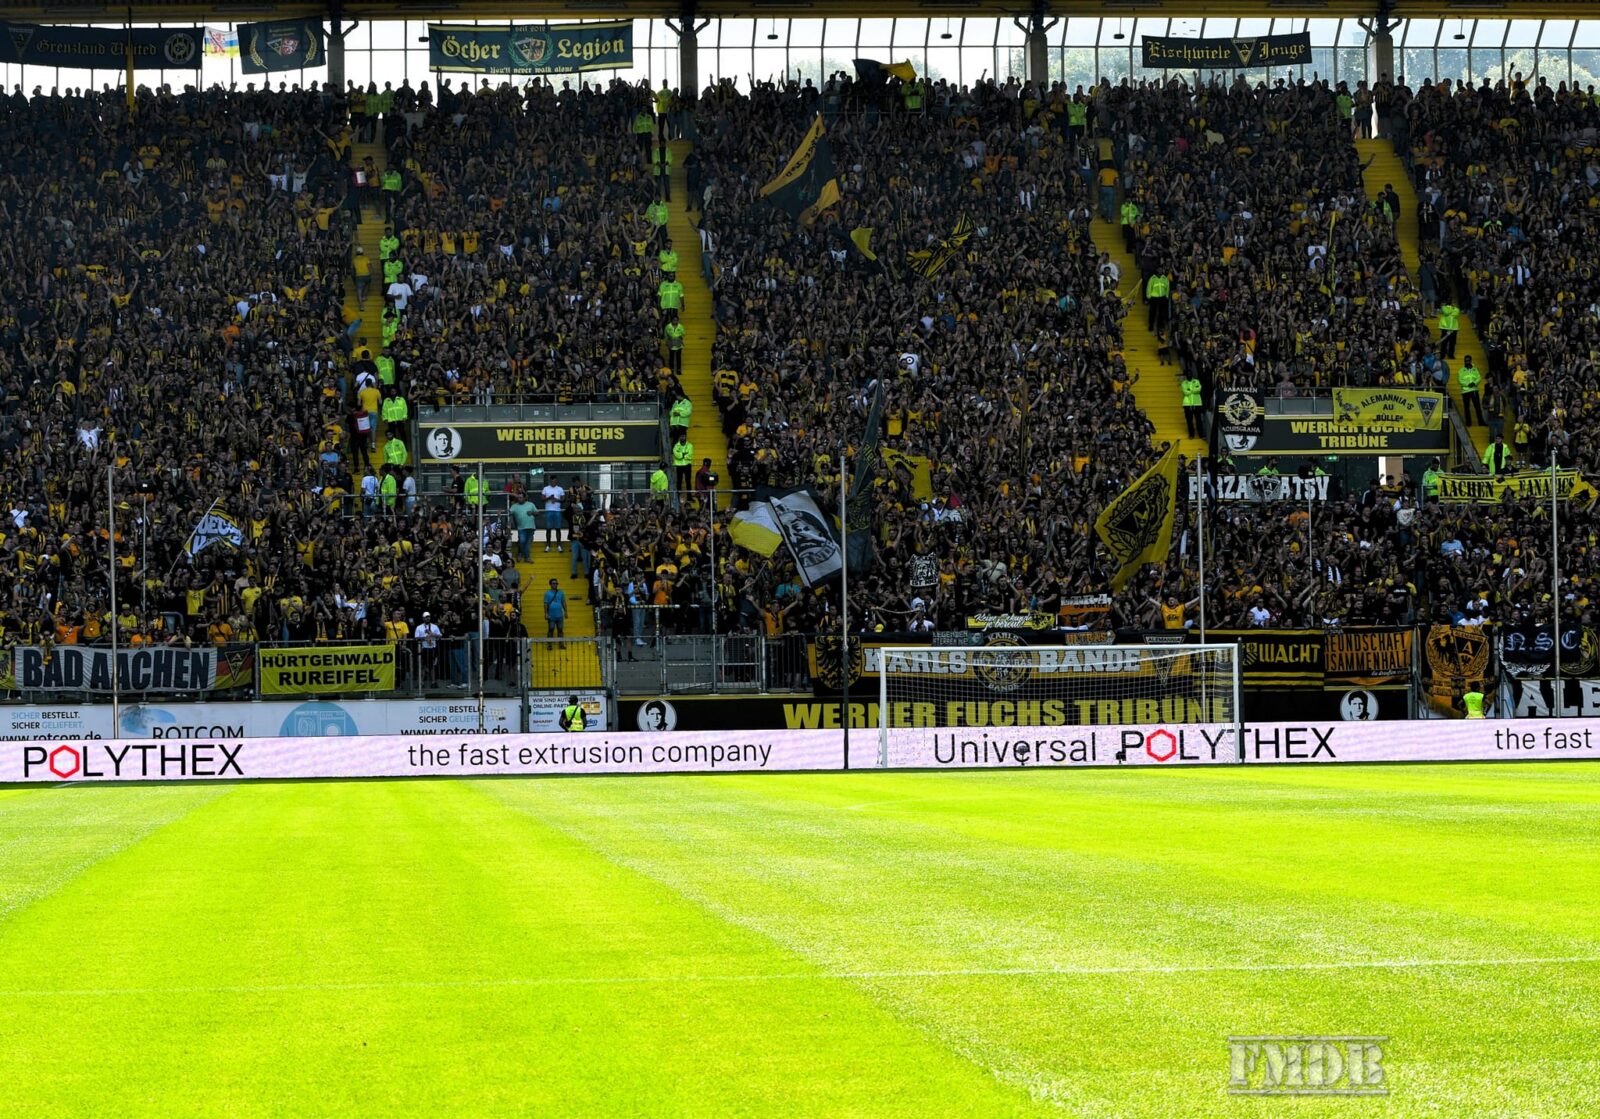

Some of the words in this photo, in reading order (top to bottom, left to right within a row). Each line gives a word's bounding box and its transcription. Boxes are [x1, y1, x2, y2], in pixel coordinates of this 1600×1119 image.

[441, 35, 501, 62] Öcher
[557, 38, 625, 60] Legion
[1146, 41, 1231, 63] Eischwiele
[497, 428, 566, 441] WERNER
[571, 427, 625, 440] FUCHS
[1319, 434, 1388, 448] TRIBÜNE
[525, 441, 597, 456] TRIBÜNE
[1440, 479, 1494, 498] AACHEN
[262, 651, 393, 668] HÜRTGENWALD
[864, 648, 967, 673] KARLS
[1038, 650, 1140, 672] BANDE
[1259, 643, 1321, 663] WACHT
[23, 649, 83, 688] BAD
[90, 649, 210, 690] AACHEN
[279, 669, 379, 687] RUREIFEL
[41, 711, 80, 719] BESTELLT.
[449, 705, 487, 713] BESTELT.
[783, 702, 936, 728] WERNER
[947, 700, 1066, 726] FUCHS
[1074, 695, 1231, 725] TRIBÜNE
[11, 721, 40, 729] SICHER
[153, 726, 243, 739] ROTCOM
[935, 732, 1096, 763] Universal
[1121, 727, 1336, 761] POLYTHEX
[1494, 728, 1535, 749] the
[1543, 727, 1592, 749] fast
[24, 744, 245, 778] POLYTHEX
[408, 744, 450, 766] the
[459, 743, 509, 766] fast
[518, 741, 643, 765] extrusion
[651, 742, 772, 768] company
